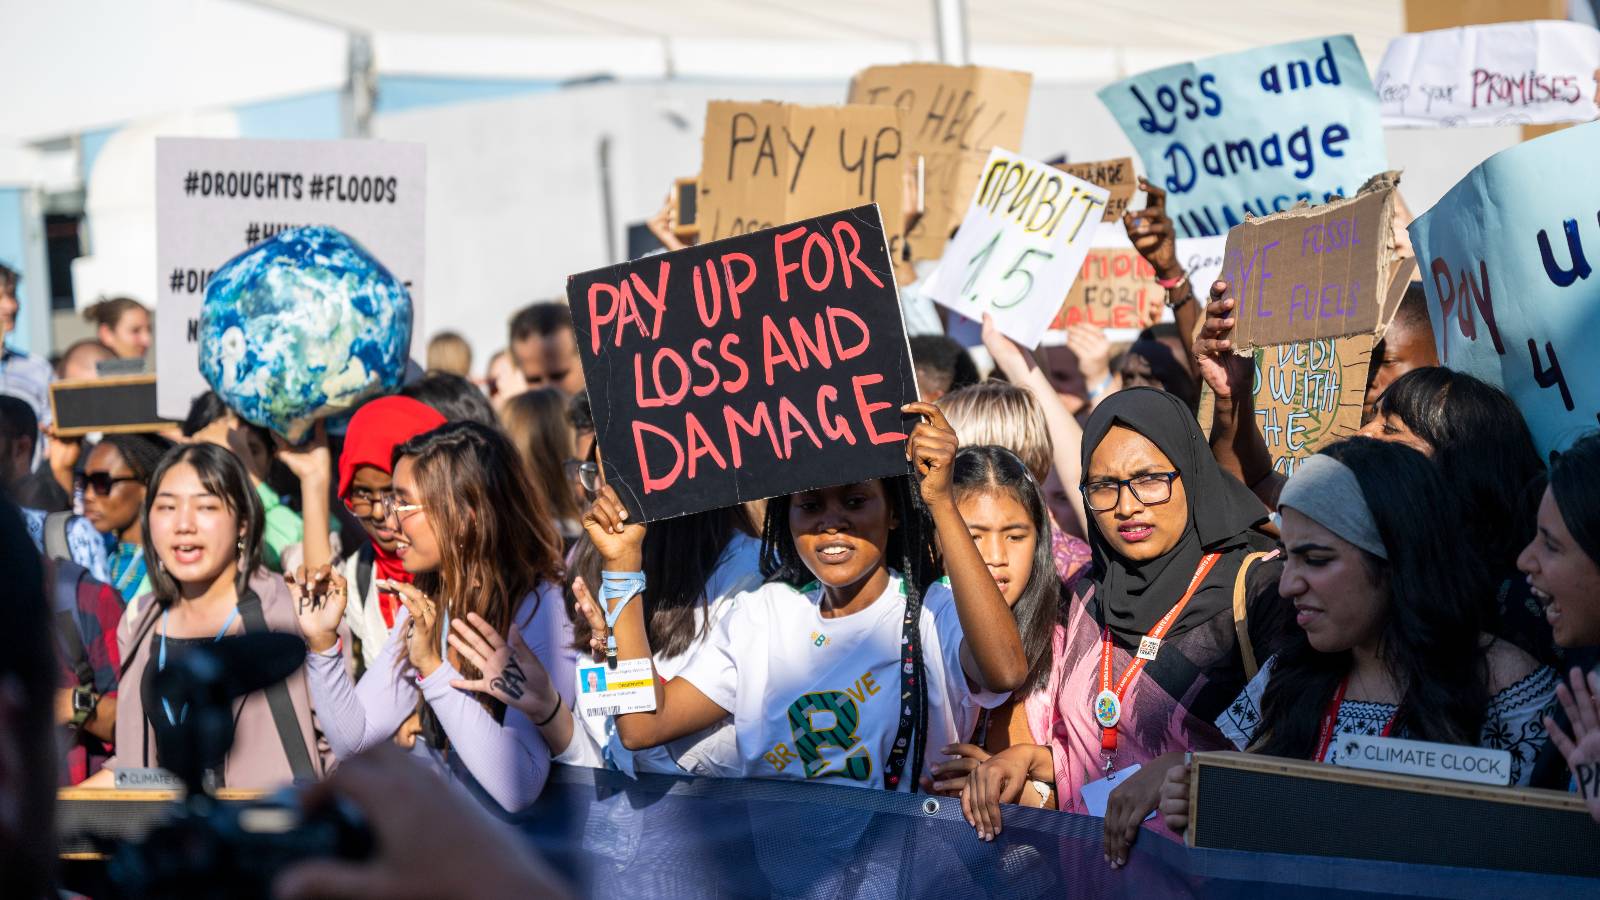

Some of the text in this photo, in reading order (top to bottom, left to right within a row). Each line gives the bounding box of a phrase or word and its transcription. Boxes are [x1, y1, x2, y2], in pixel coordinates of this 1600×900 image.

[1130, 41, 1341, 134] Loss and
[184, 171, 397, 203] #DROUGHTS #FLOODS
[727, 113, 815, 194] PAY
[838, 126, 902, 202] UP
[1164, 123, 1350, 194] Damage
[588, 261, 670, 355] PAY
[693, 253, 757, 328] UP
[774, 220, 884, 302] FOR
[1085, 286, 1134, 307] FOR
[1288, 280, 1361, 326] FUELS
[634, 305, 870, 408] LOSS AND
[1268, 366, 1340, 413] WITH
[1528, 338, 1575, 411] 4
[632, 374, 909, 494] DAMAGE
[128, 773, 172, 784] CLIMATE
[1364, 744, 1500, 775] CLIMATE CLOCK
